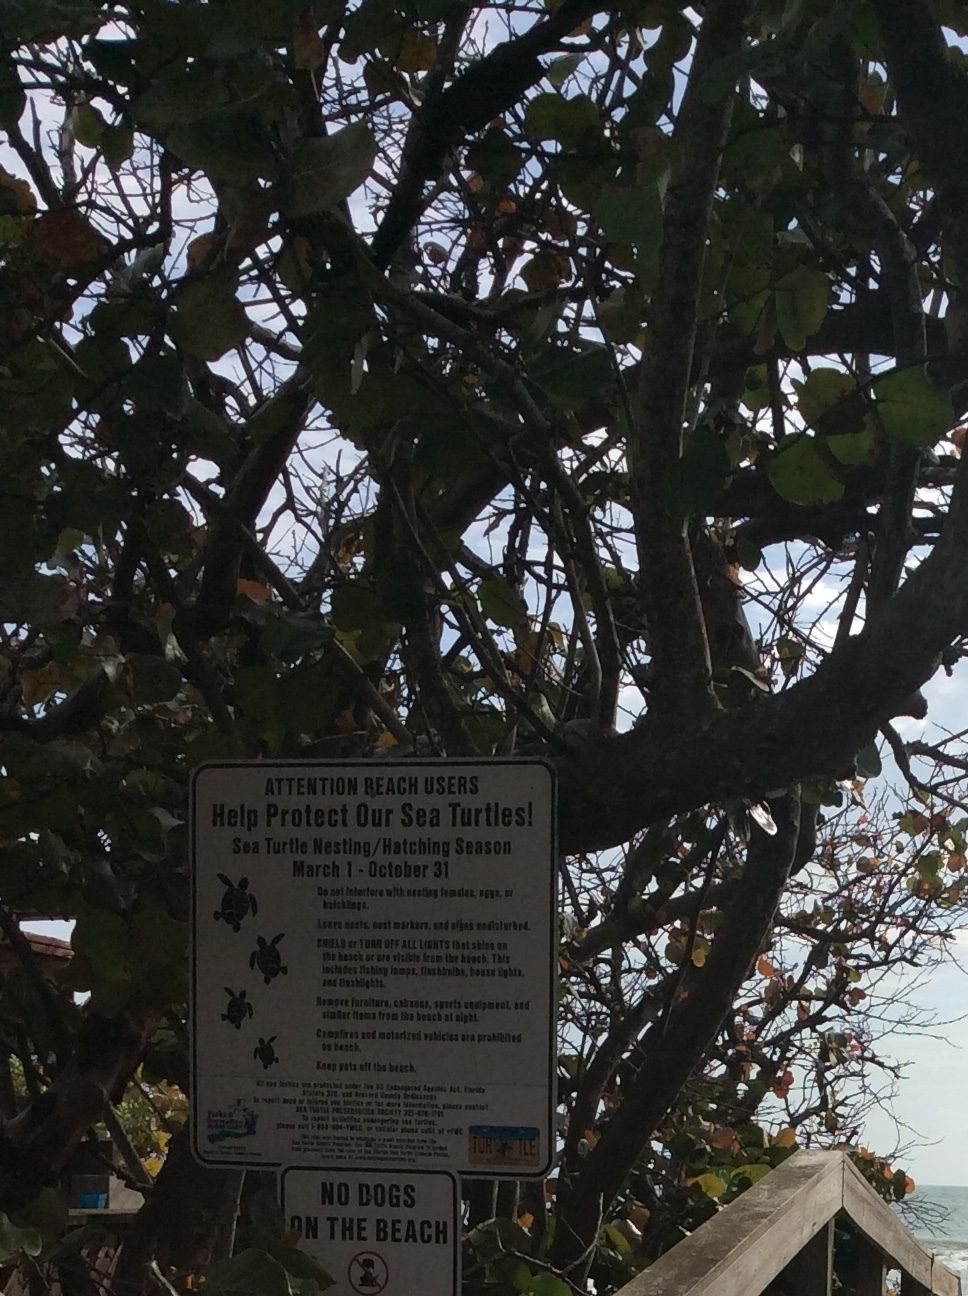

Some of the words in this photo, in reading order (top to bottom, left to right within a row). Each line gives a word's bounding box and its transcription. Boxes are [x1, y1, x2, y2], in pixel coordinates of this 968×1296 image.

[265, 776, 358, 796] ATTENTION
[364, 776, 418, 796] BEACH
[424, 776, 479, 796] USERS
[212, 803, 258, 831] Help
[266, 803, 349, 828] Protect
[356, 803, 393, 828] Our
[401, 803, 440, 828] Sea
[448, 802, 534, 828] Turtles!
[232, 838, 260, 855] Sea
[265, 838, 308, 855] Turtle
[313, 837, 451, 857] Nesting/Hatching
[455, 837, 512, 855] Season
[292, 861, 340, 878] March
[346, 861, 353, 878] 1
[368, 861, 430, 879] October
[433, 861, 450, 879] 31
[317, 887, 328, 896] Do
[330, 887, 344, 896] not
[346, 886, 384, 897] interfere
[386, 886, 404, 897] with
[407, 887, 438, 899] nesting
[504, 889, 513, 897] or
[433, 920, 449, 930] and
[317, 938, 346, 949] SHIELD
[348, 941, 357, 949] or
[360, 939, 382, 949] TURN
[384, 939, 400, 949] OFF
[402, 939, 417, 950] ALL
[419, 939, 450, 950] LIGHTS
[452, 940, 469, 950] that
[322, 952, 336, 961] the
[338, 952, 363, 962] beach
[393, 952, 420, 962] visible
[423, 953, 443, 963] from
[445, 953, 459, 963] the
[492, 954, 510, 964] This
[322, 978, 337, 987] and
[316, 996, 349, 1007] Remove
[433, 1000, 461, 1010] sports
[514, 1000, 529, 1010] and
[378, 1011, 398, 1021] from
[401, 1011, 414, 1021] the
[416, 1012, 442, 1022] beach
[444, 1013, 453, 1022] at
[316, 1028, 359, 1039] Campfires
[361, 1030, 377, 1040] and
[379, 1030, 422, 1041] motorized
[424, 1031, 458, 1041] vehicles
[477, 1032, 522, 1043] prohibited
[316, 1060, 336, 1072] Keep
[339, 1062, 357, 1072] pets
[359, 1062, 371, 1072] off
[373, 1062, 386, 1072] the
[321, 1182, 349, 1206] NO
[358, 1183, 416, 1208] DOGS
[290, 1215, 318, 1239] ON
[326, 1217, 368, 1241] THE
[376, 1218, 448, 1244] BEACH
